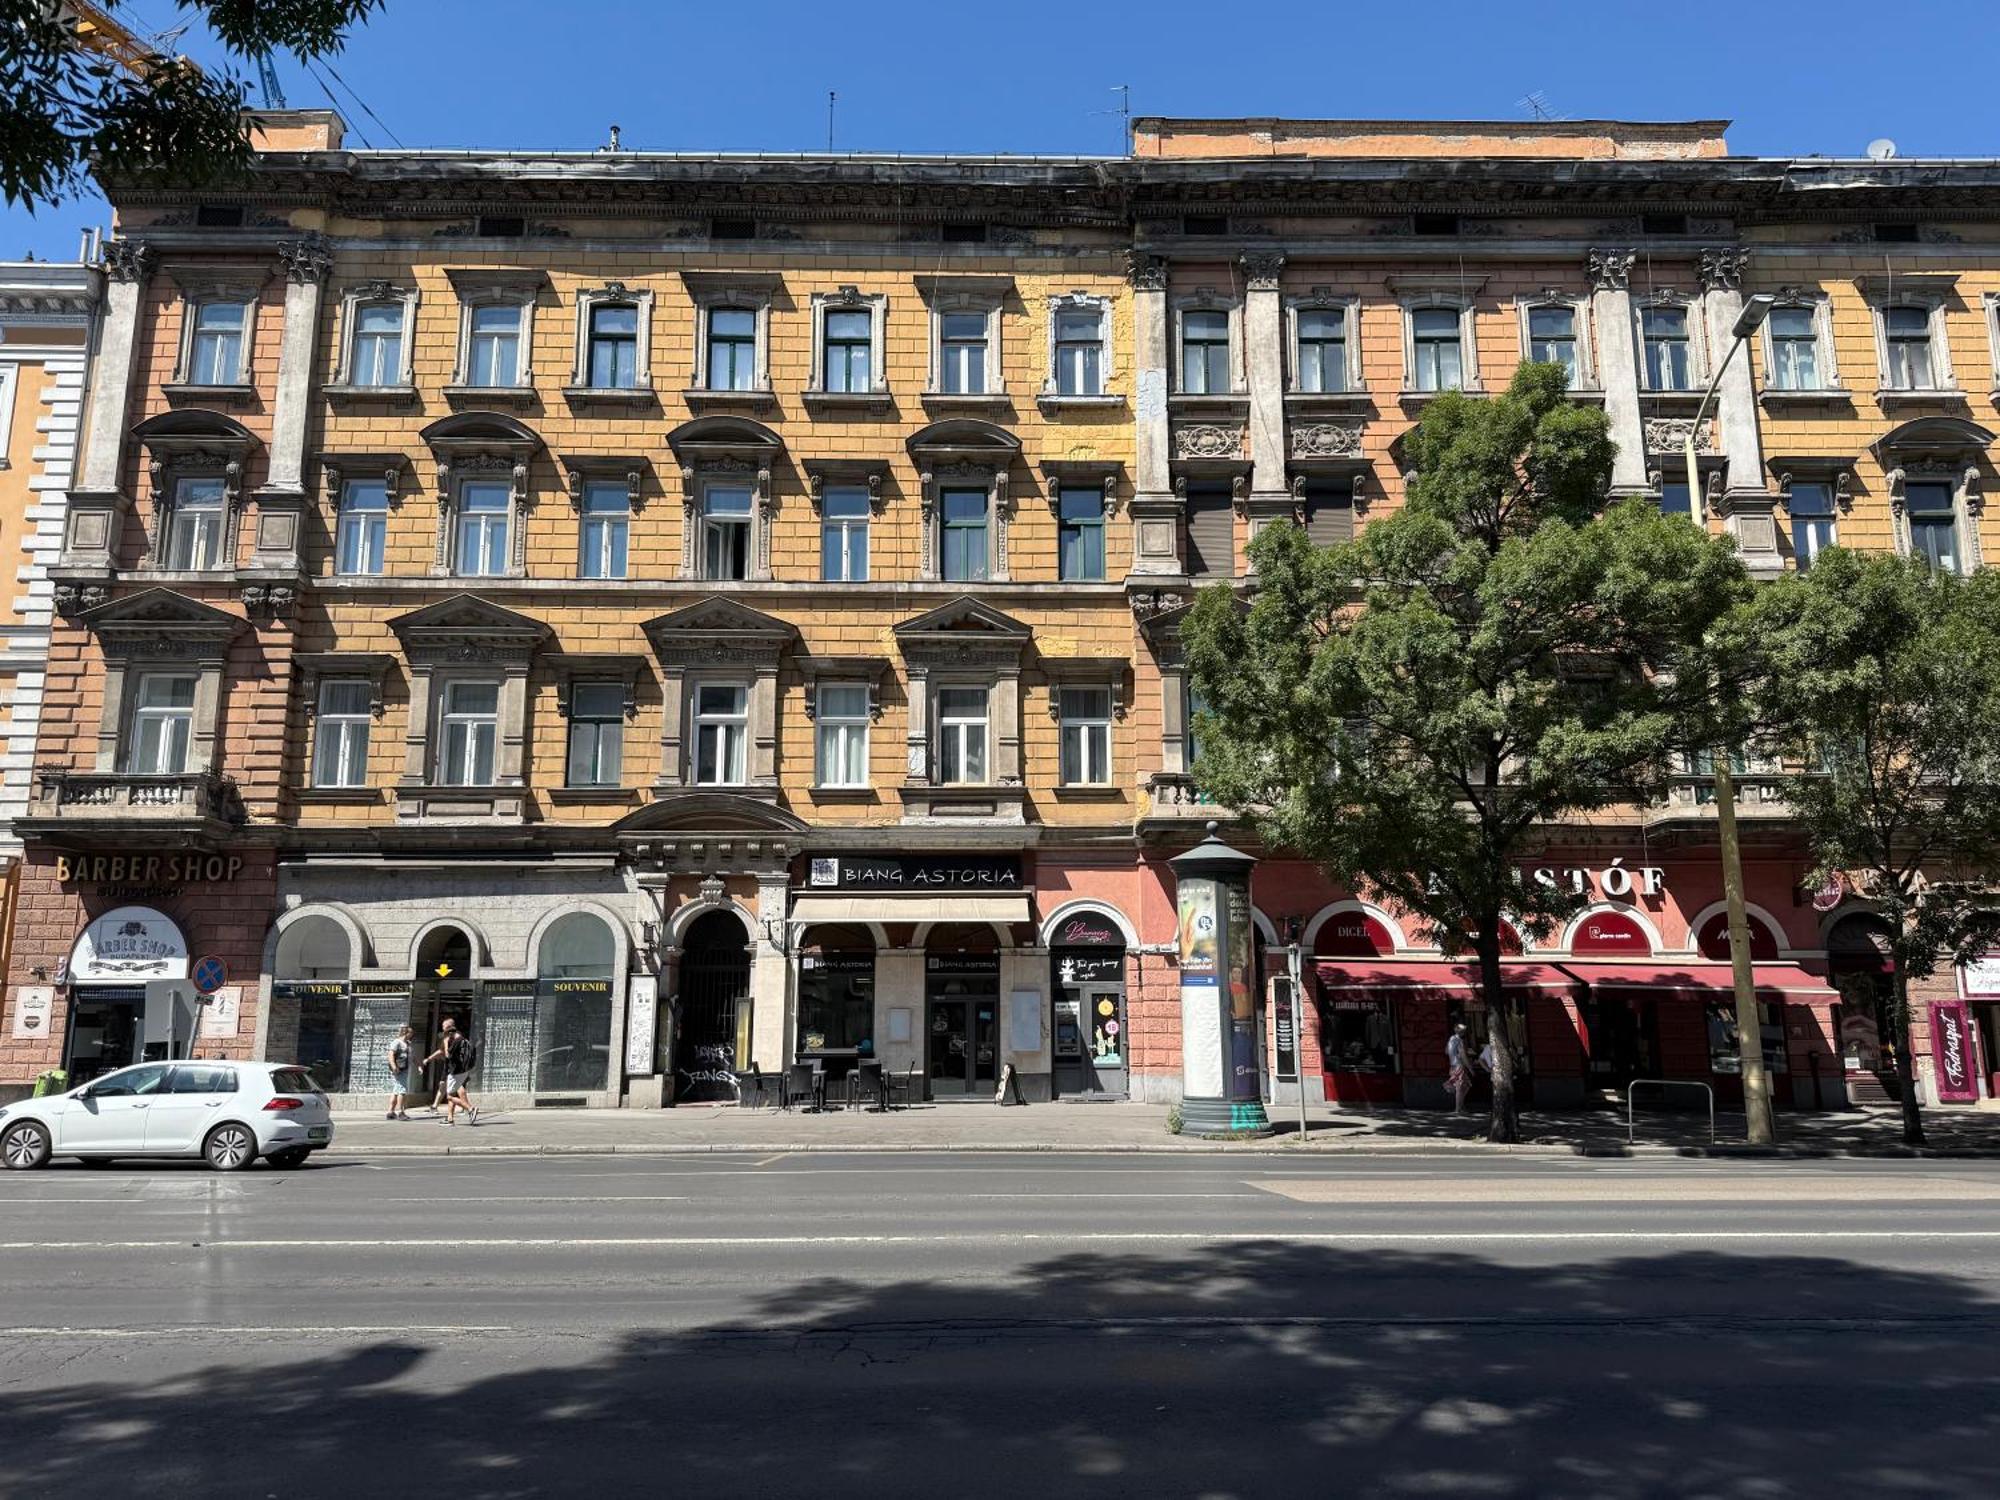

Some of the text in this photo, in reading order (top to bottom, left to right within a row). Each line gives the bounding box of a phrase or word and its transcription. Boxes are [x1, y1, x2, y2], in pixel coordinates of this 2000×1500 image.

[56, 856, 242, 881] BARBER SHOP
[844, 868, 904, 881] BIANG
[913, 868, 1015, 883] ASTORIA
[140, 939, 177, 958] SHOP
[290, 984, 342, 993] SOUVENIR
[356, 984, 410, 993] BUDAPEST
[554, 983, 607, 992] SOUVENIR
